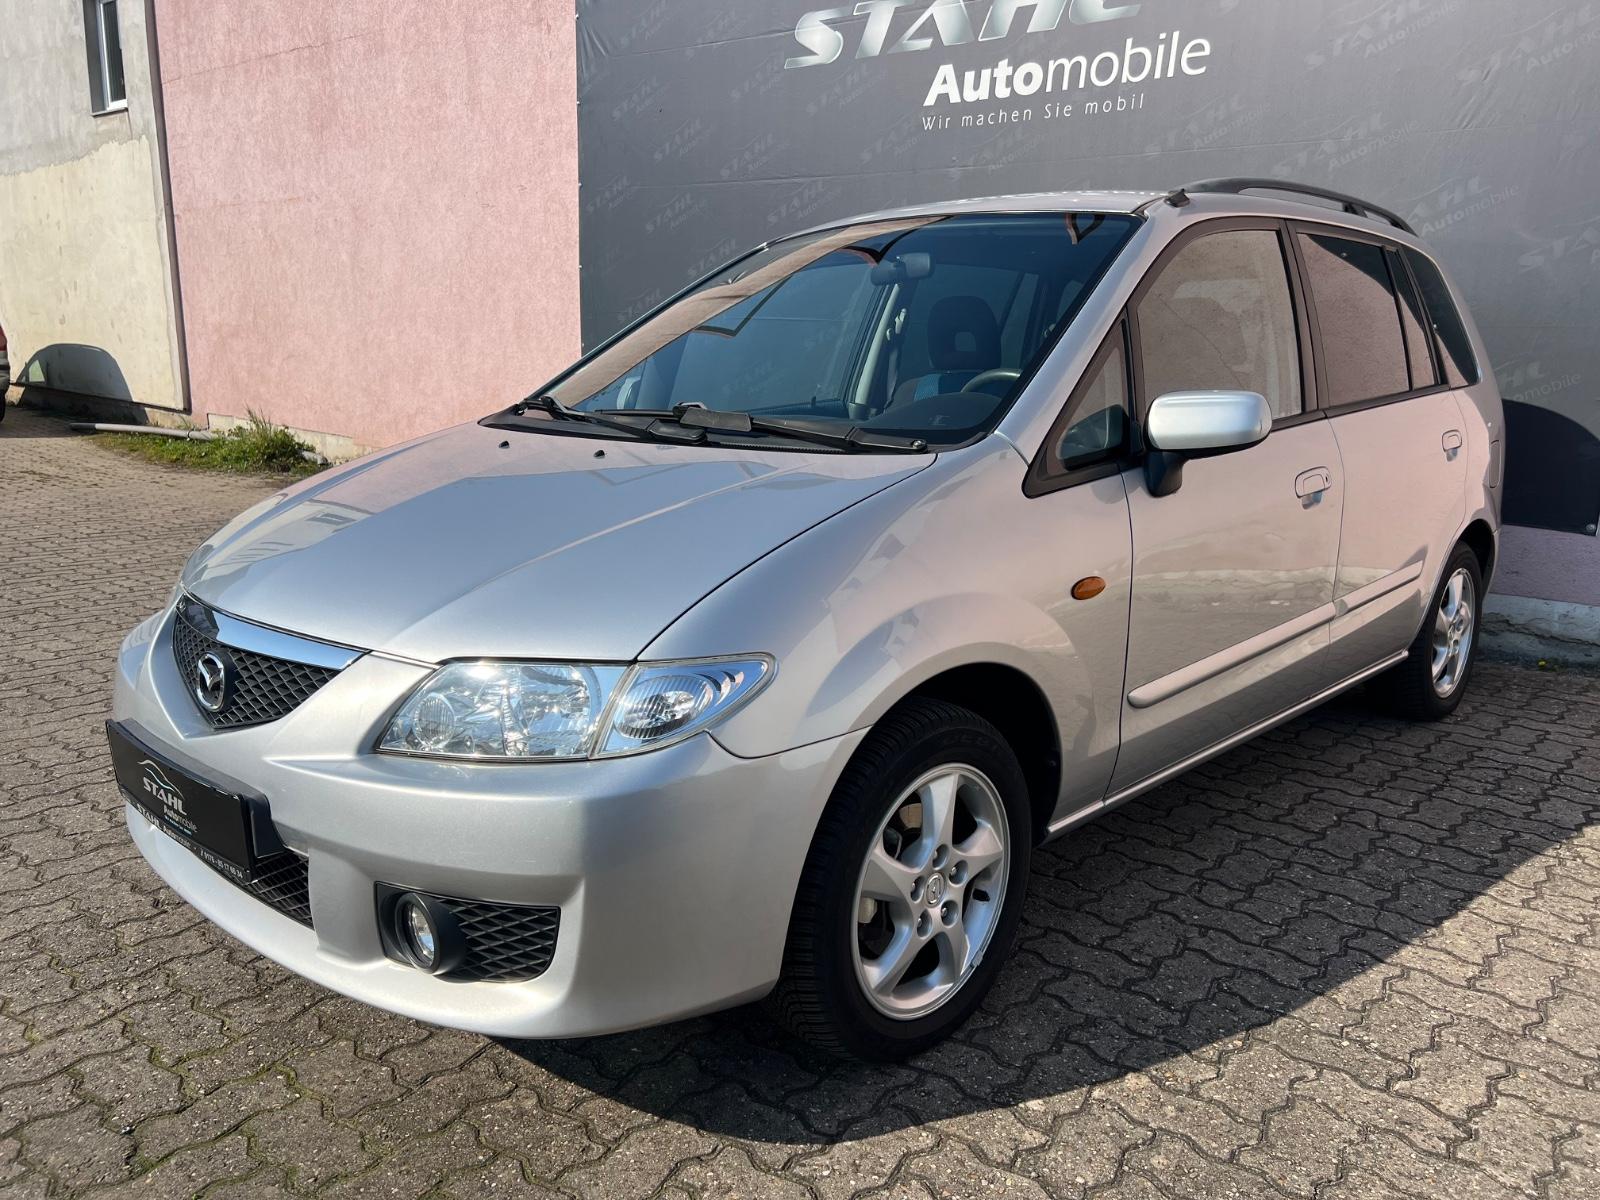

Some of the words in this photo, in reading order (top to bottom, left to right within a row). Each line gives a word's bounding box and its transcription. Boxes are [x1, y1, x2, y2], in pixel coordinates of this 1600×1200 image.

[923, 31, 1211, 107] Automobile
[922, 115, 951, 131] Wir
[961, 109, 1033, 127] machen
[1043, 103, 1073, 119] Sie
[1085, 93, 1144, 115] mobil
[1421, 184, 1521, 237] Automobile
[143, 776, 187, 816] STAHL
